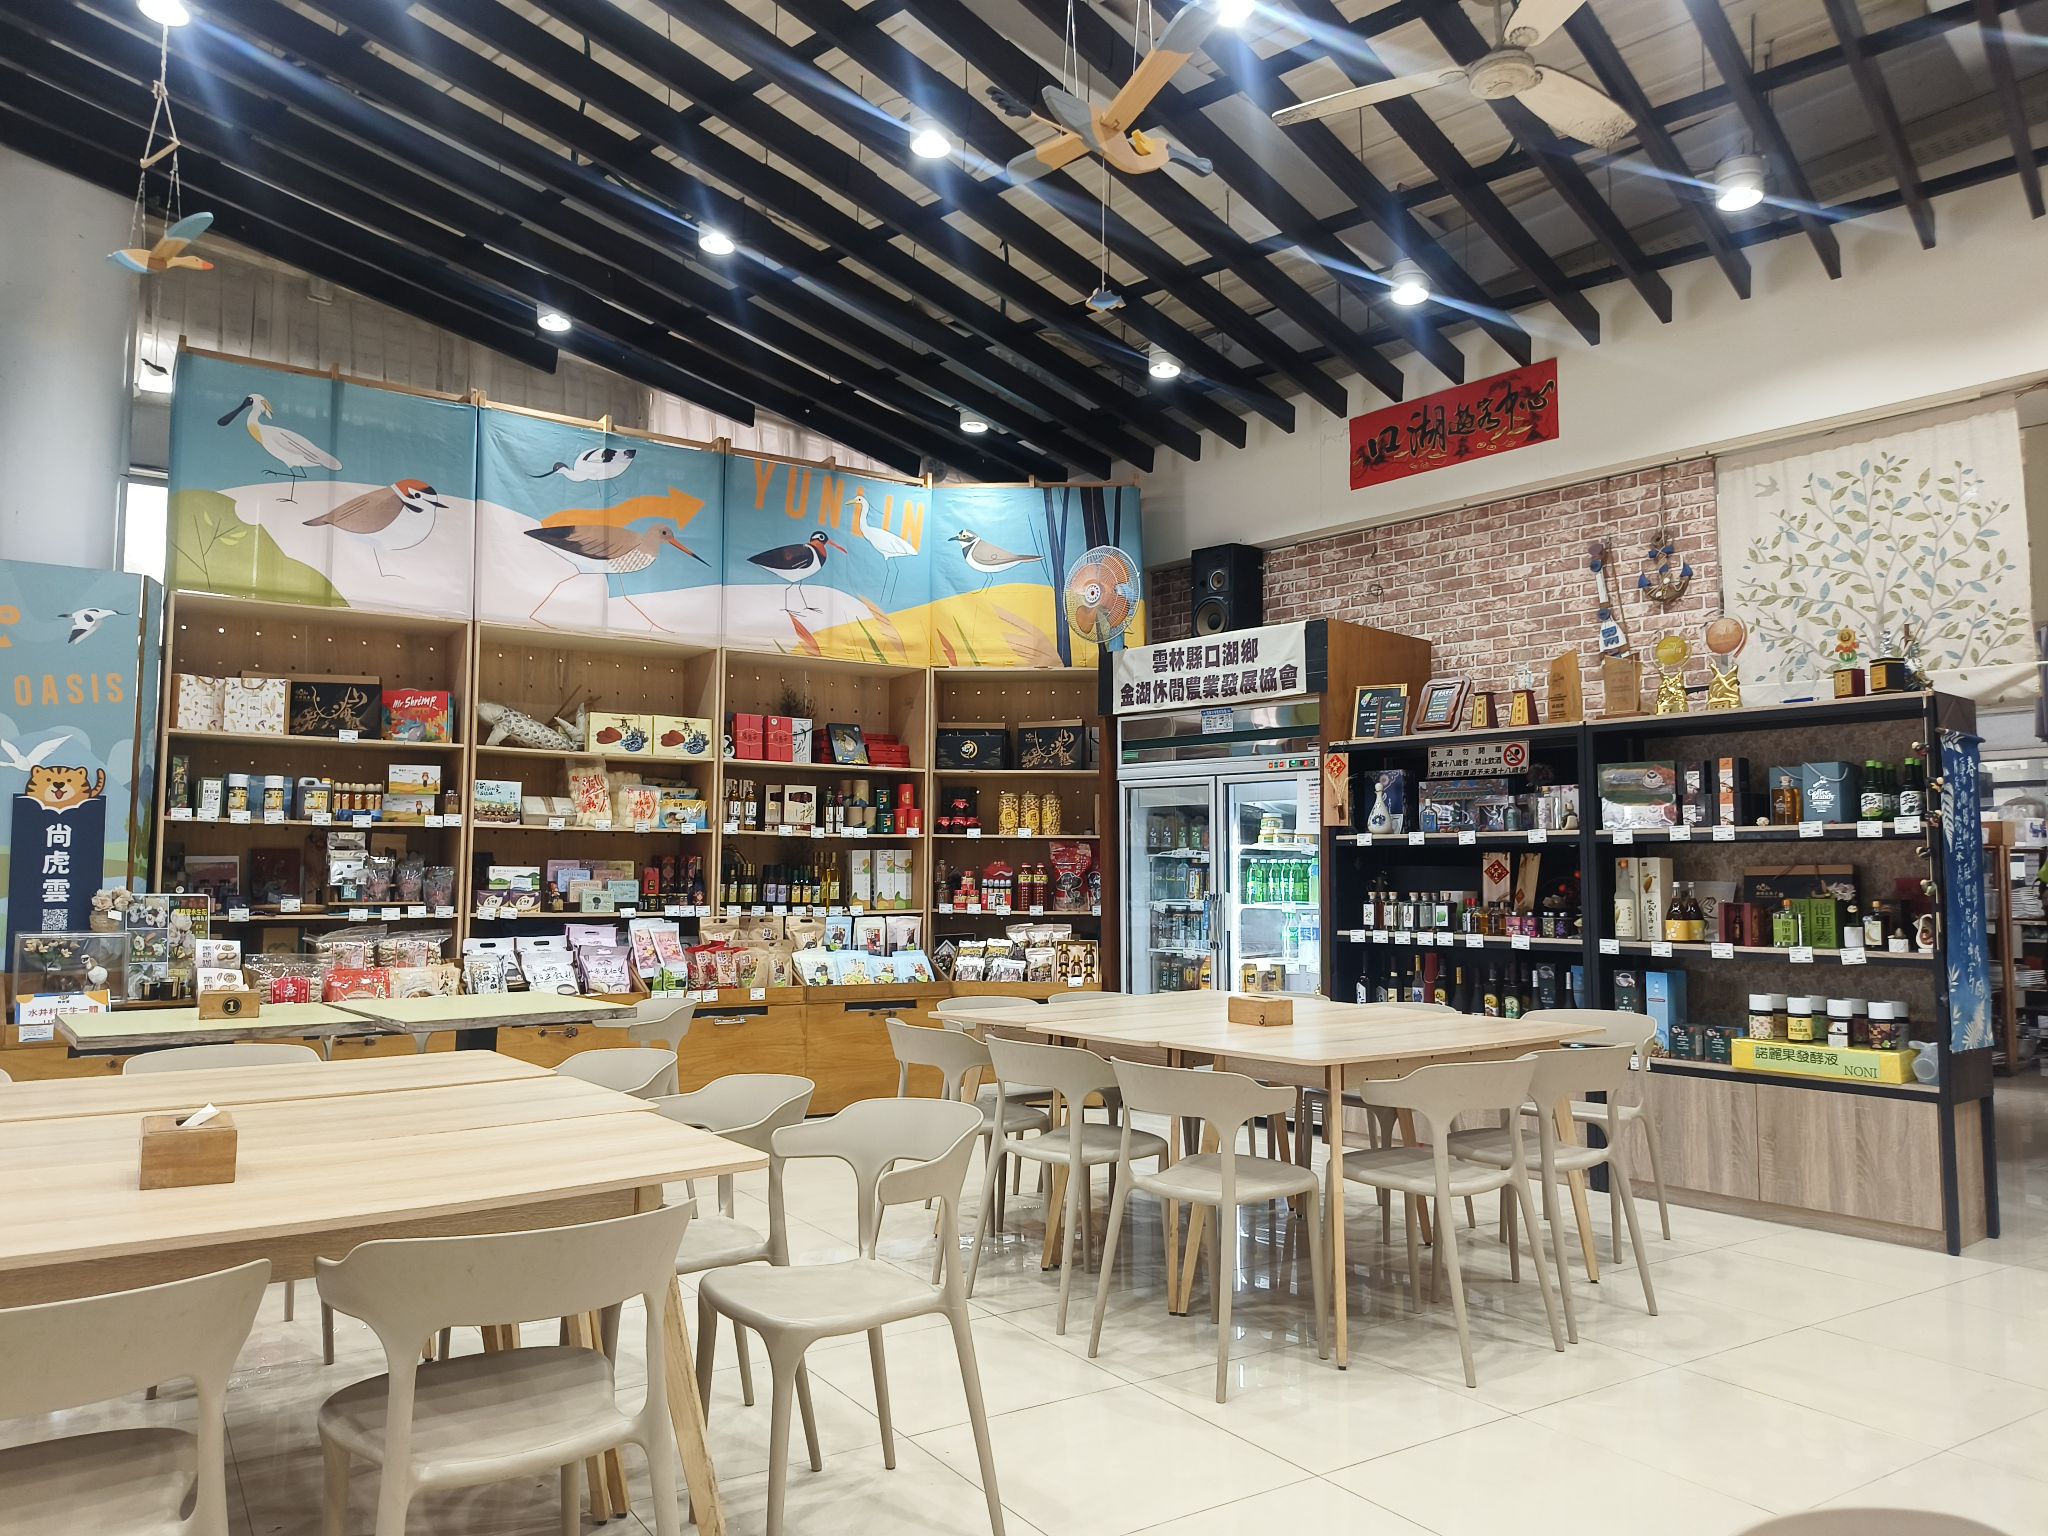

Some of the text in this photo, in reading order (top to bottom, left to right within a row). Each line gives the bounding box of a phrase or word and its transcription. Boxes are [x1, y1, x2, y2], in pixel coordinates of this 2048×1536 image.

[1152, 637, 1260, 674] 雲林縣口湖鄉
[14, 673, 124, 707] OASIS
[1120, 663, 1299, 707] 金湖休閒農業發展協會
[42, 823, 72, 903] 尚虎雲
[227, 1001, 236, 1012] 1
[1259, 1014, 1265, 1025] 3
[1755, 1046, 1840, 1067] 諾麗果發酵液
[1844, 1065, 1878, 1079] NONI
